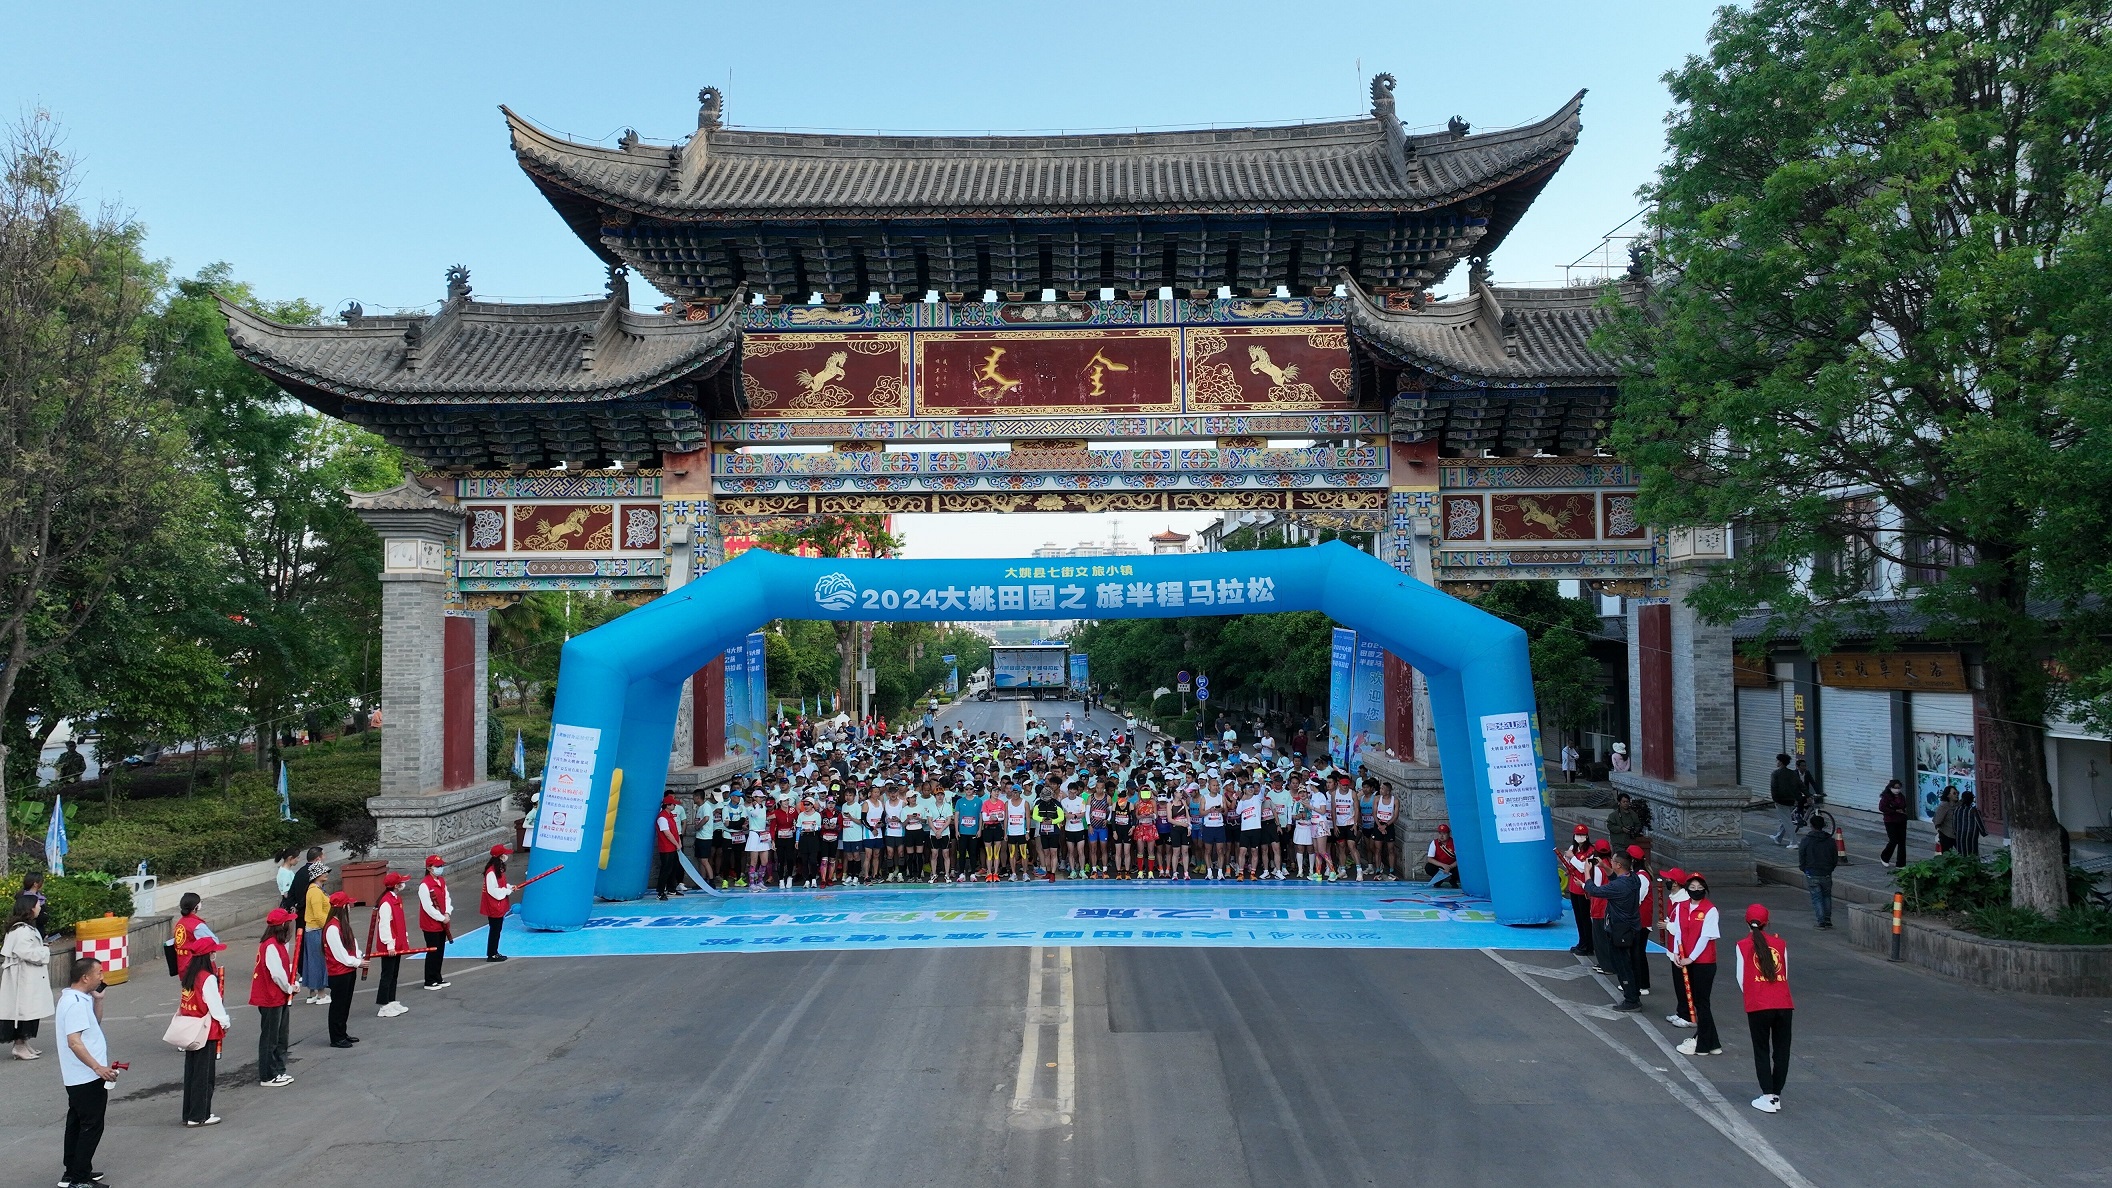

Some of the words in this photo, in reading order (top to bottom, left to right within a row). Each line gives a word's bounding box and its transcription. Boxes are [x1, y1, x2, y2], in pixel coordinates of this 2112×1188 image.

[1005, 565, 1133, 579] 大姚县七街文旅小镇
[861, 576, 1276, 611] 2024大姚田园之旅半程马拉松
